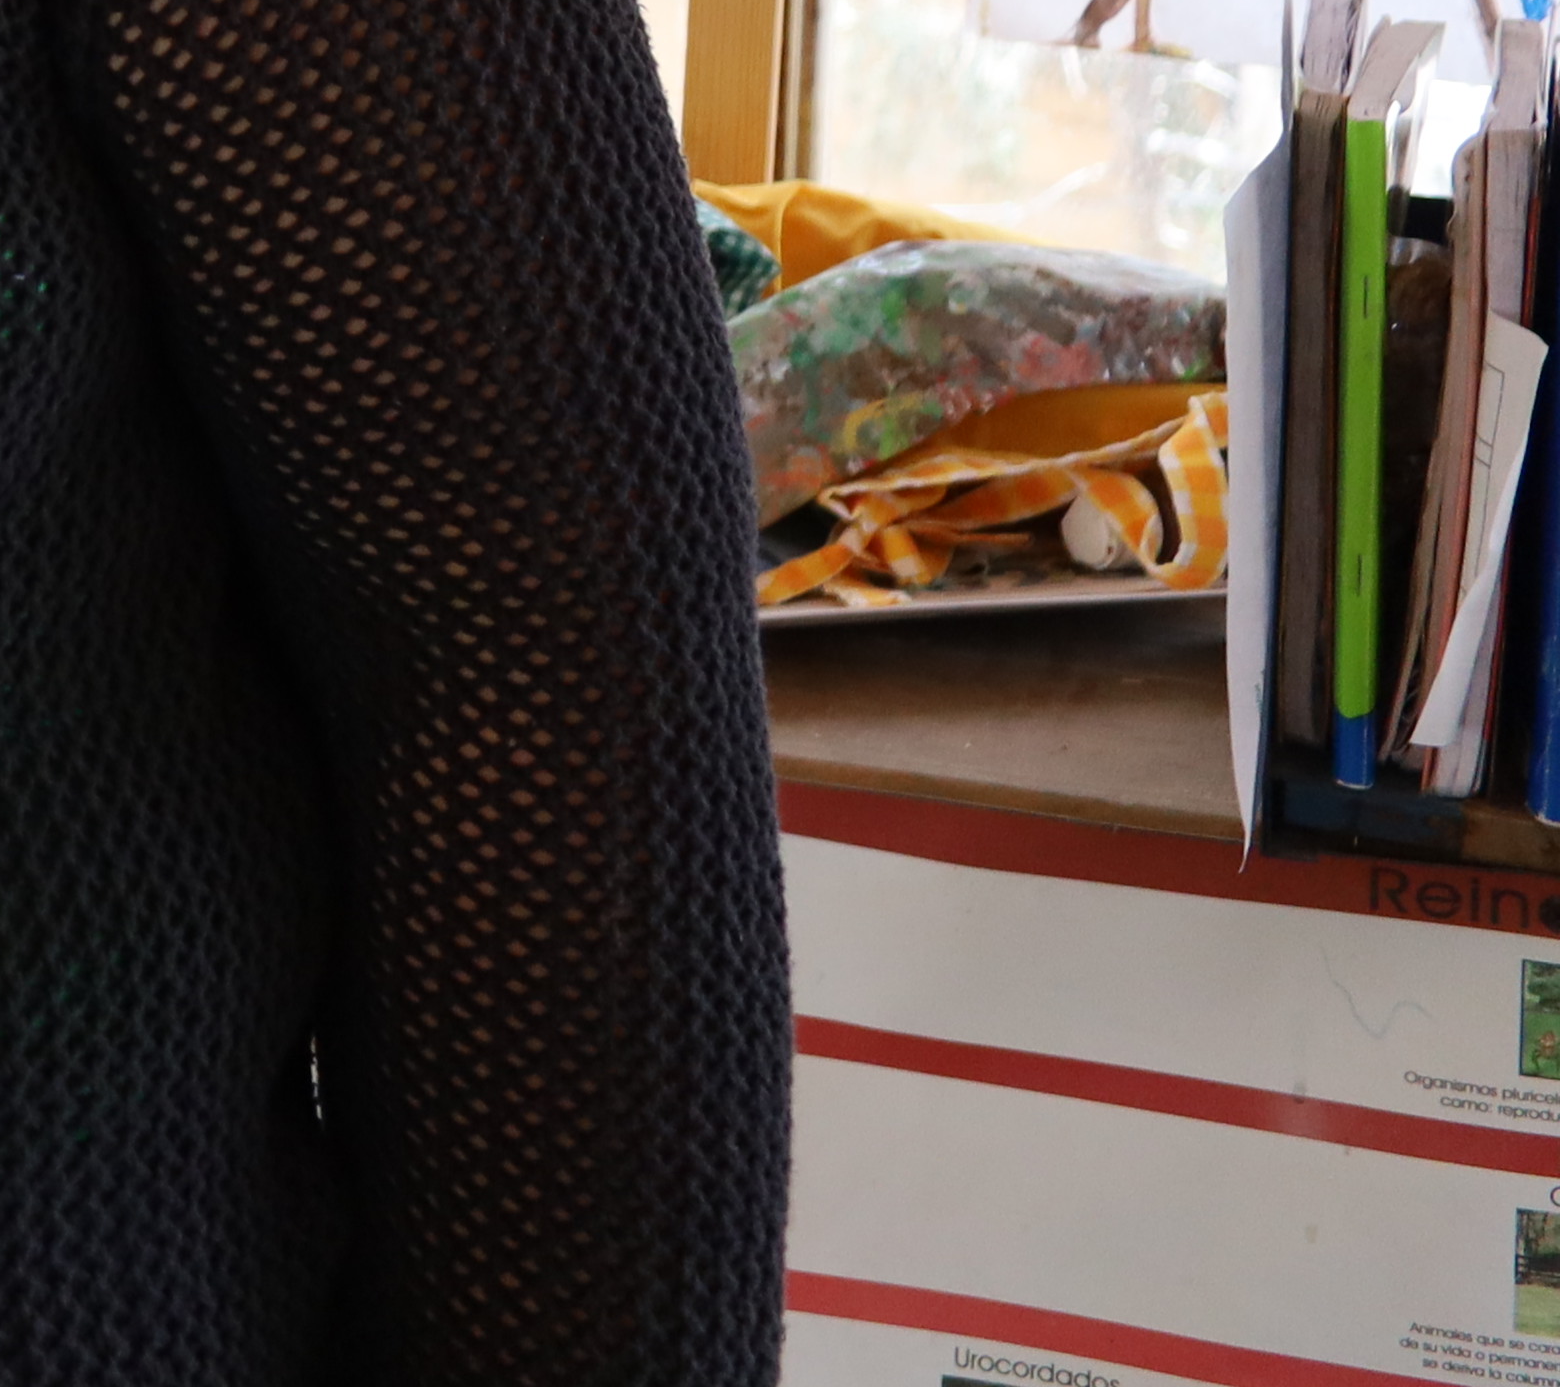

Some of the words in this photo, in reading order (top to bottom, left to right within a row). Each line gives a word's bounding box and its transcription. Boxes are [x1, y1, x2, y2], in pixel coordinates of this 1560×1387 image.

[1404, 1070, 1497, 1097] Organismos
[1399, 1337, 1419, 1350] de
[1423, 1341, 1438, 1353] su
[1441, 1344, 1472, 1358] vida
[1409, 1322, 1473, 1343] Animales
[1476, 1335, 1505, 1347] que
[1509, 1339, 1525, 1350] se
[954, 1346, 1120, 1387] Urocordados
